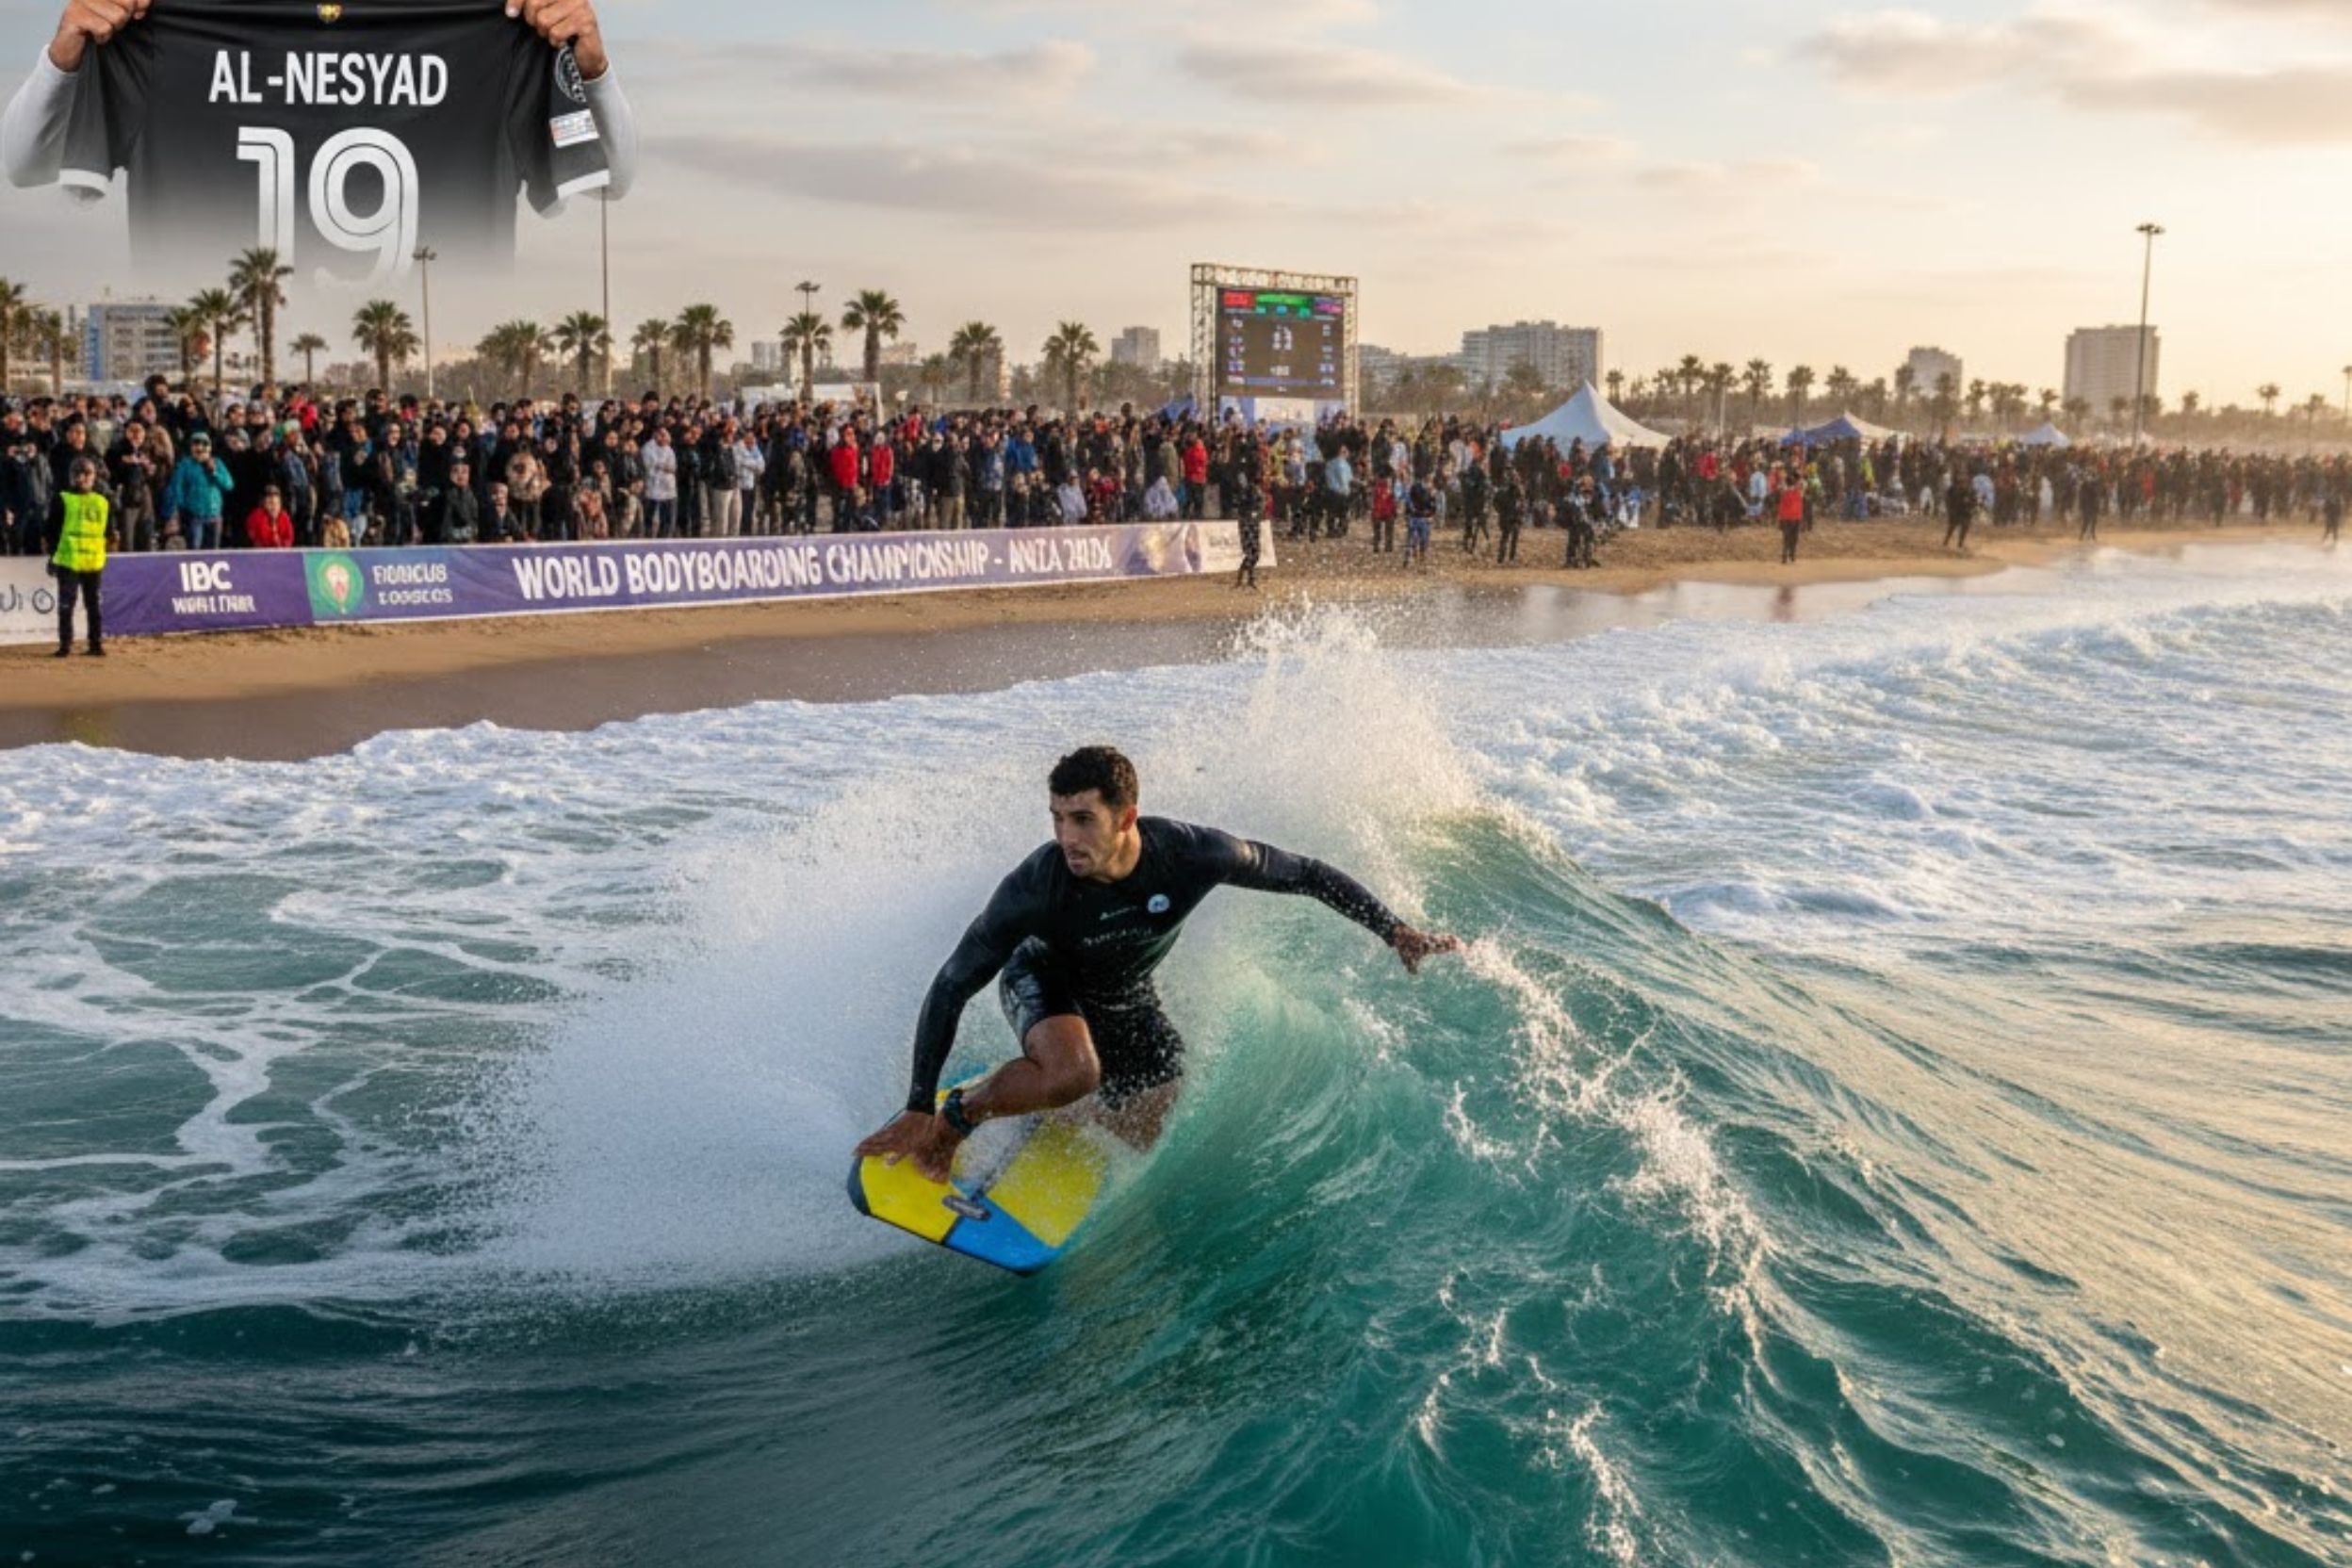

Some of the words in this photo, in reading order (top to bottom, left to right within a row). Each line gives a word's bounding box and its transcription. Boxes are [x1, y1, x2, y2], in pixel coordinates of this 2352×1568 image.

[208, 50, 449, 106] AL-NESYAD
[237, 126, 418, 286] 19
[180, 561, 233, 593] IBC
[512, 555, 619, 600] WORLD
[624, 546, 823, 595] BODYBOARDING
